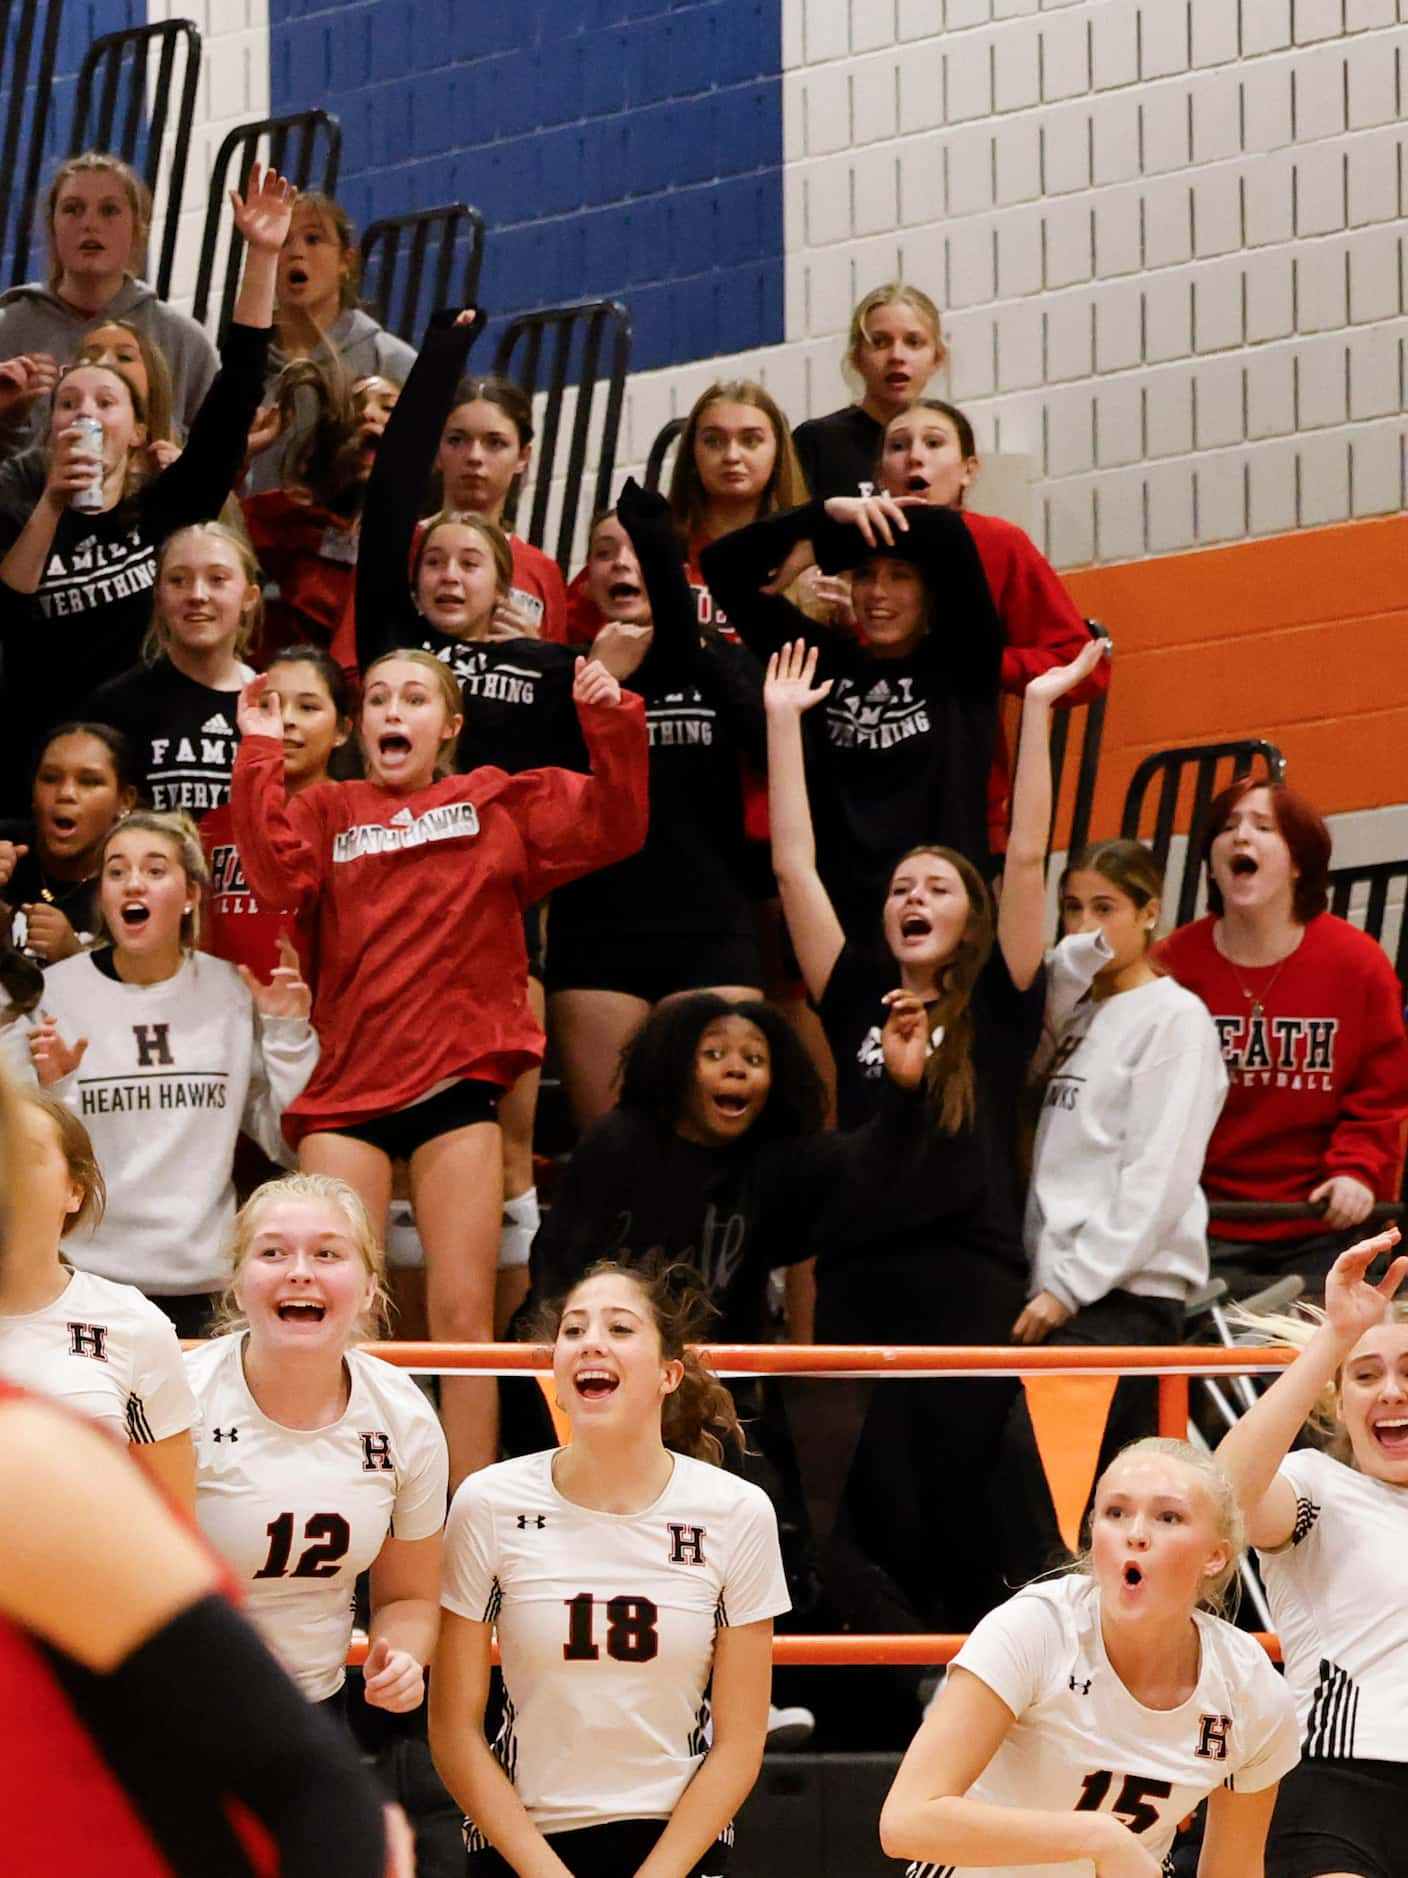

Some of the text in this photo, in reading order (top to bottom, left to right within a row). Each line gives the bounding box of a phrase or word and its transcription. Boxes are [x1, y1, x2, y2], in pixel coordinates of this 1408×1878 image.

[40, 560, 157, 619] VERYTHING
[458, 672, 534, 704] THING
[151, 738, 239, 765] FAM
[647, 720, 713, 746] THING
[132, 1023, 175, 1067] H
[1211, 1015, 1339, 1073] EATH
[81, 1083, 227, 1115] HEATH HAWKS
[1230, 1071, 1333, 1092] EYBALL
[66, 1321, 109, 1363] H
[358, 1432, 396, 1473] H
[252, 1512, 351, 1580] 12
[667, 1522, 707, 1567] H
[562, 1592, 659, 1664] 18
[1194, 1713, 1233, 1761] H
[1073, 1769, 1173, 1835] 15
